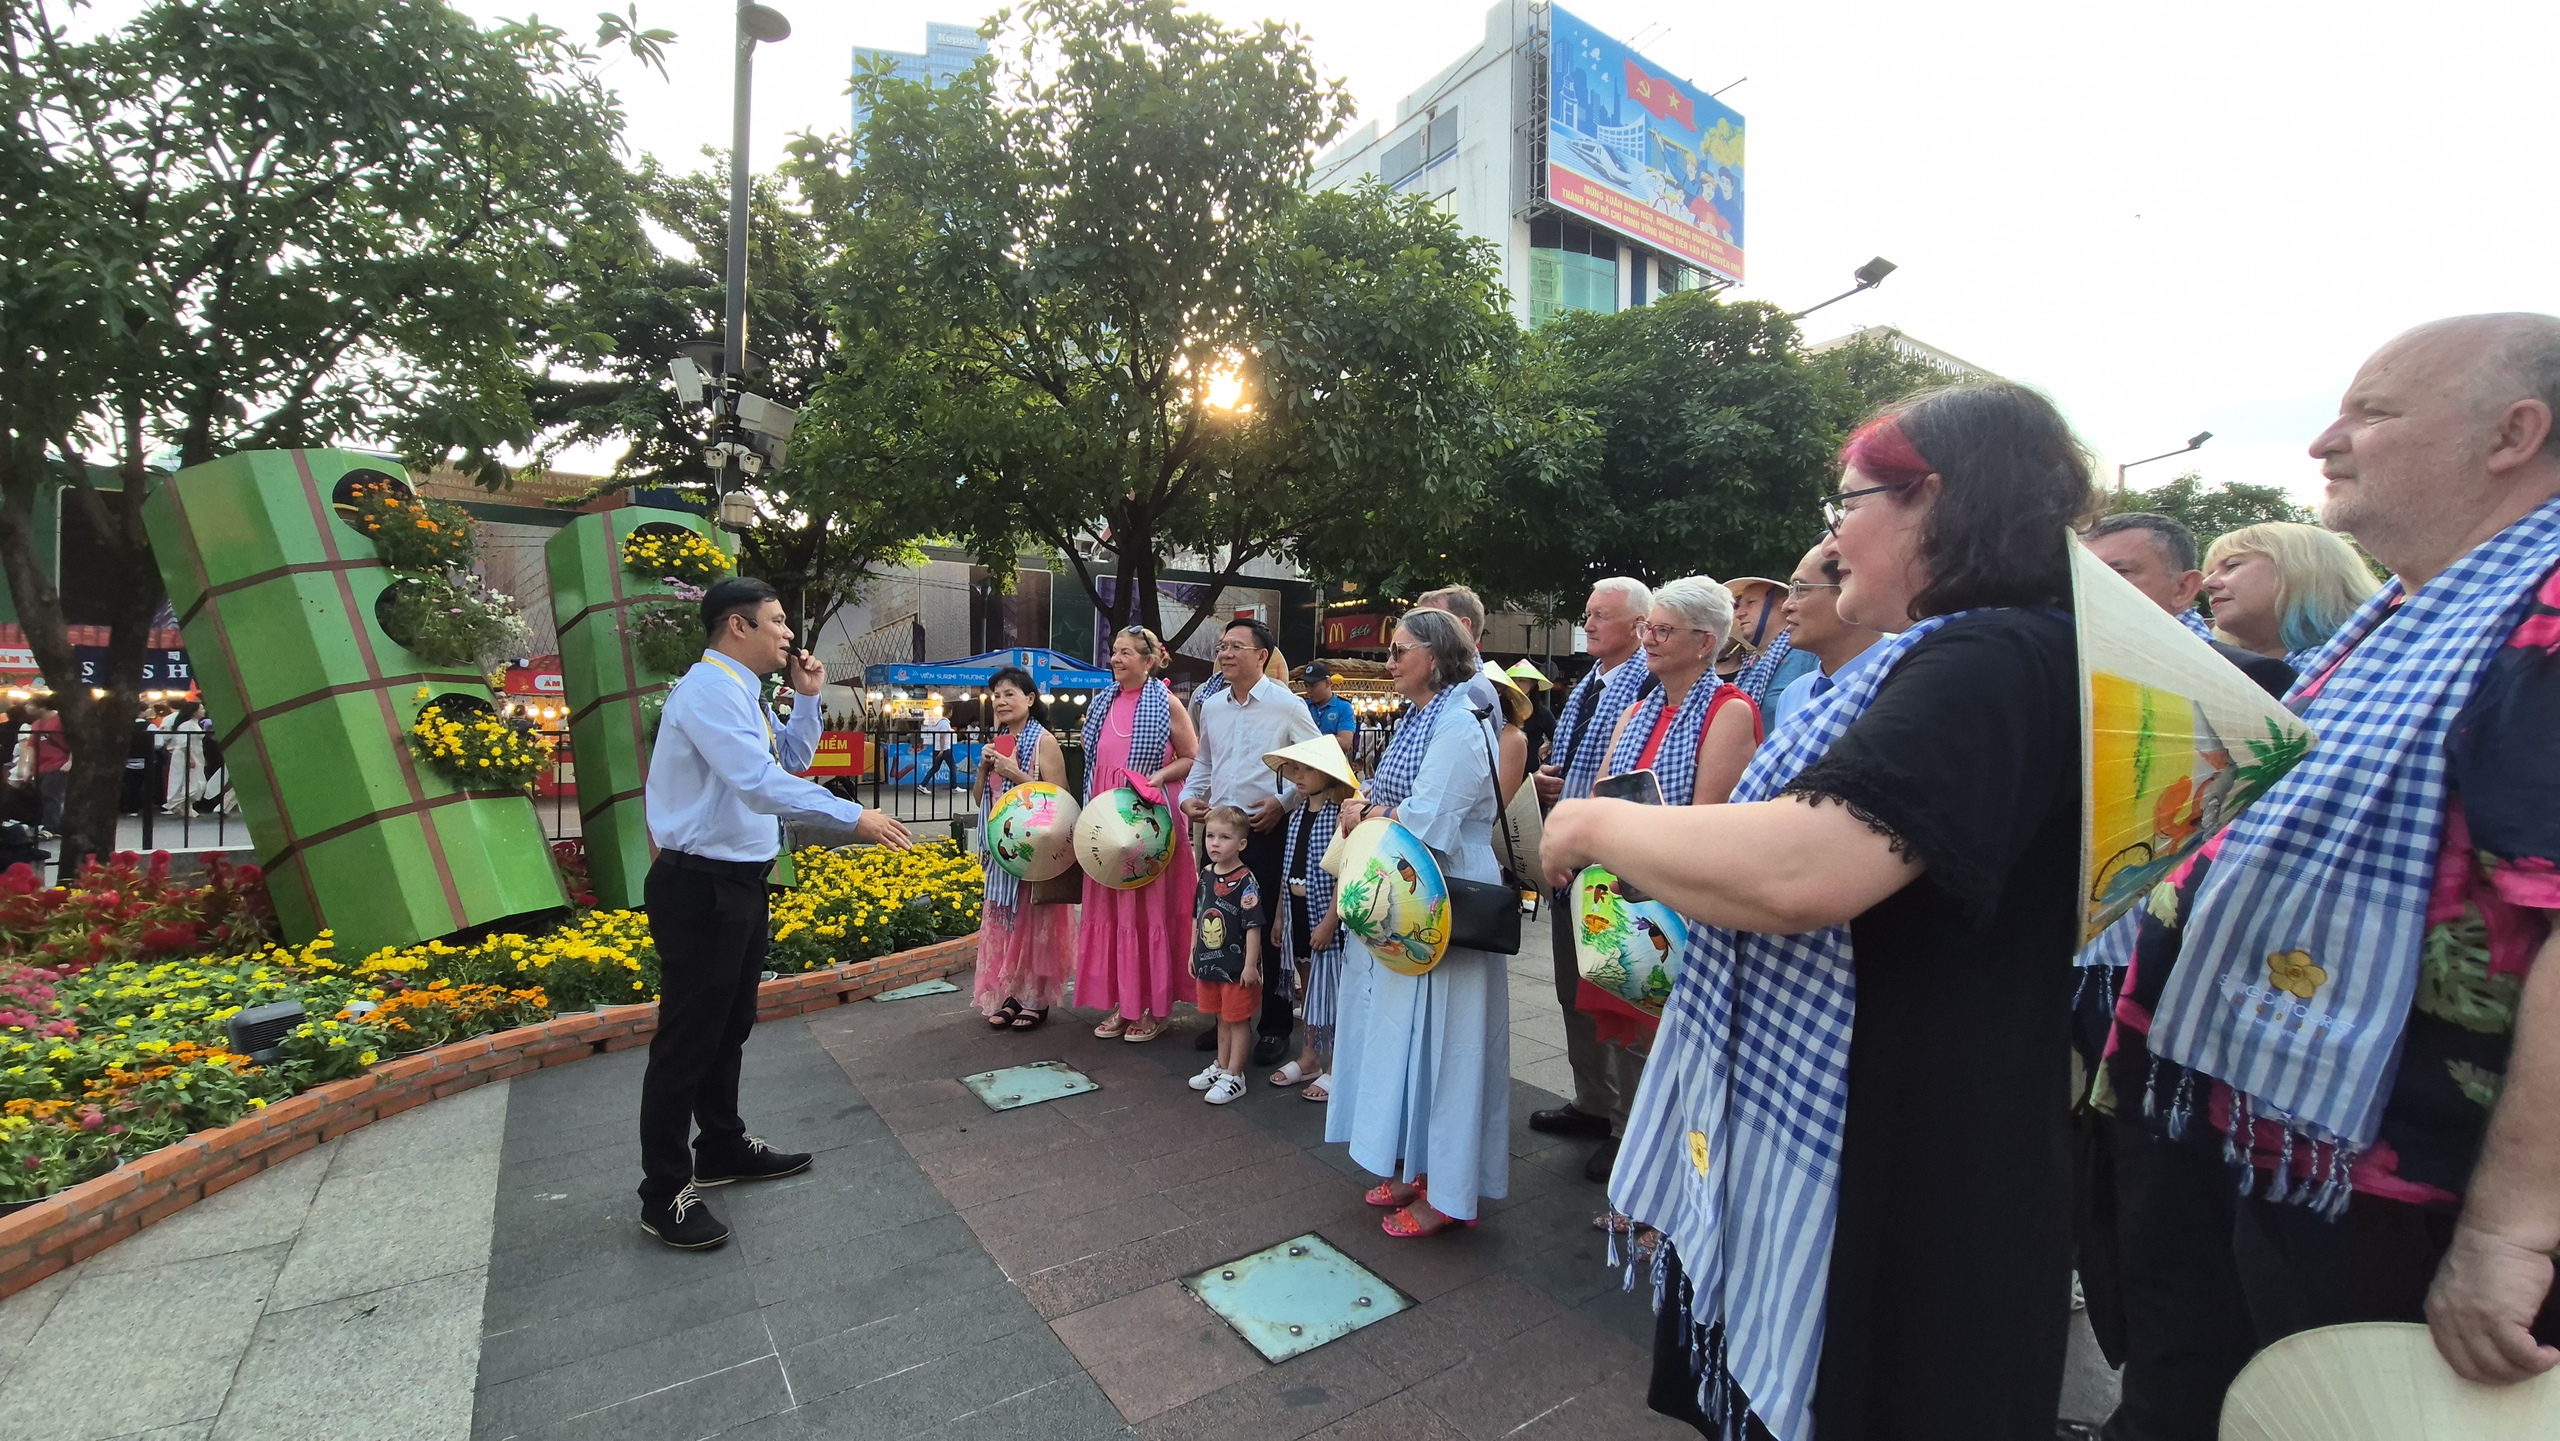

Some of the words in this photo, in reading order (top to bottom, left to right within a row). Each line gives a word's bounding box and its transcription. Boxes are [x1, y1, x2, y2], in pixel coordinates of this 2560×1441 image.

[937, 32, 976, 46] Keppel
[1562, 187, 1585, 206] THÀNH
[1605, 193, 1623, 209] XUÂN
